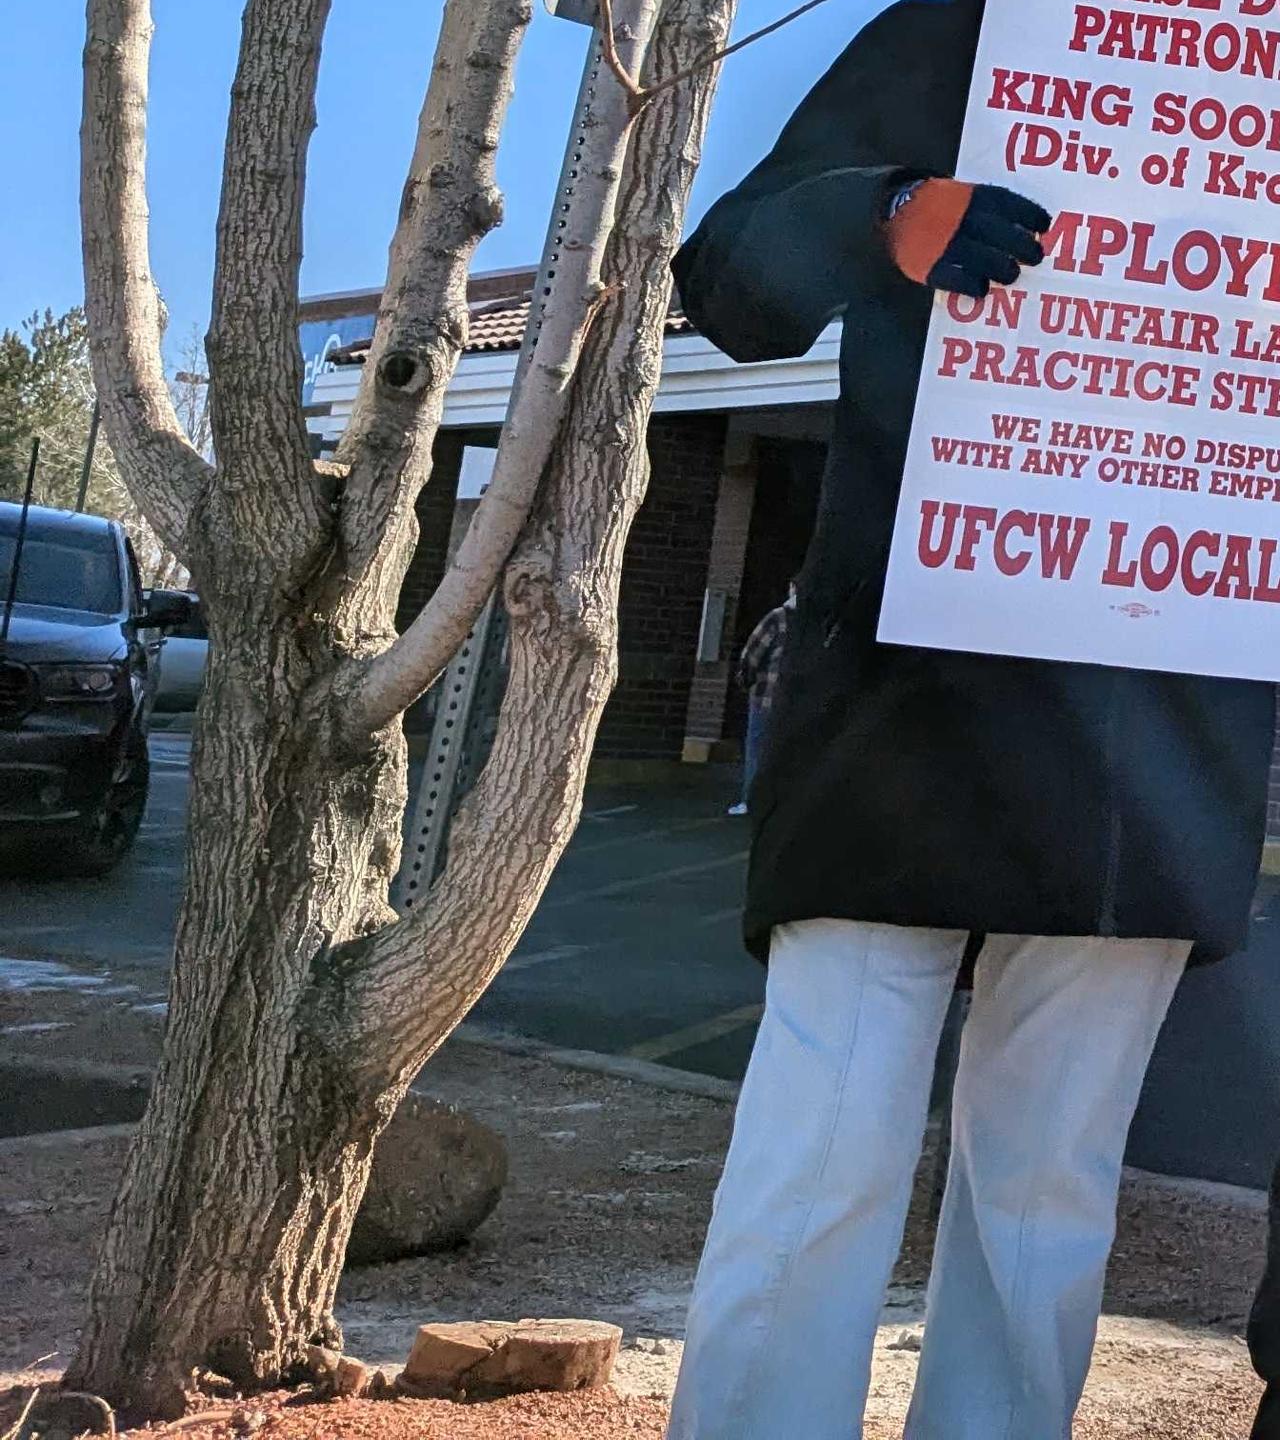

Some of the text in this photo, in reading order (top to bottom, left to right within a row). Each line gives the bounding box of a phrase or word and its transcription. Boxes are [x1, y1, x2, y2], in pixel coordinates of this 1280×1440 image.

[986, 68, 1134, 126] KING
[1004, 123, 1120, 178] (Div.
[1141, 145, 1189, 188] of
[945, 287, 1027, 329] ON
[1038, 293, 1221, 354] UNFAIR
[938, 337, 1202, 406] PRACTICE
[931, 439, 1013, 469] WITH
[1021, 447, 1087, 476] ANY
[1098, 458, 1202, 489] OTHER
[991, 415, 1040, 443] WE
[1049, 423, 1134, 454] HAVE
[1142, 433, 1187, 461] NO
[917, 500, 1090, 579] UFCW
